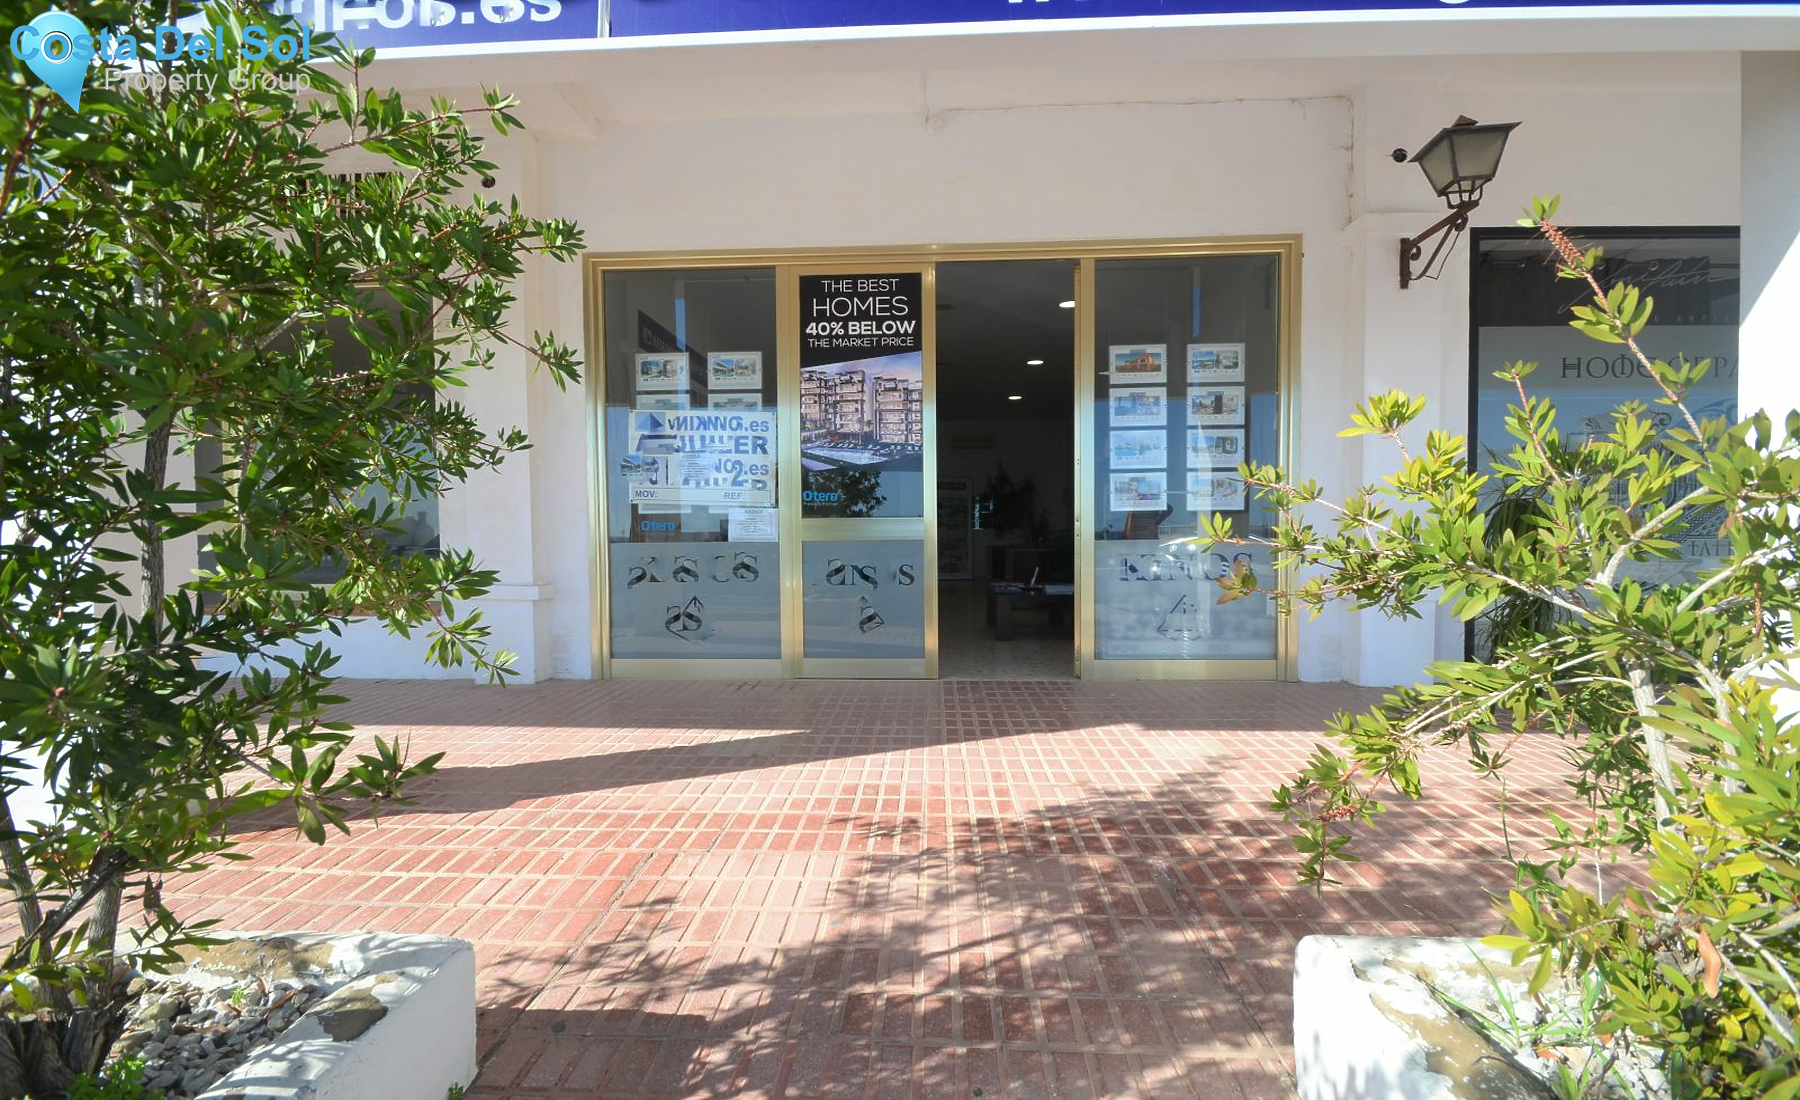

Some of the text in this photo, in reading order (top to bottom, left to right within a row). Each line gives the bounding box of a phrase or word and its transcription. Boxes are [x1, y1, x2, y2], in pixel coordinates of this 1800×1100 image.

[821, 278, 899, 293] THE BEST
[812, 296, 908, 317] HOMES
[805, 320, 915, 336] 40% BELOW
[808, 336, 914, 348] THE MARKET PRICE
[635, 490, 658, 499] MOV:
